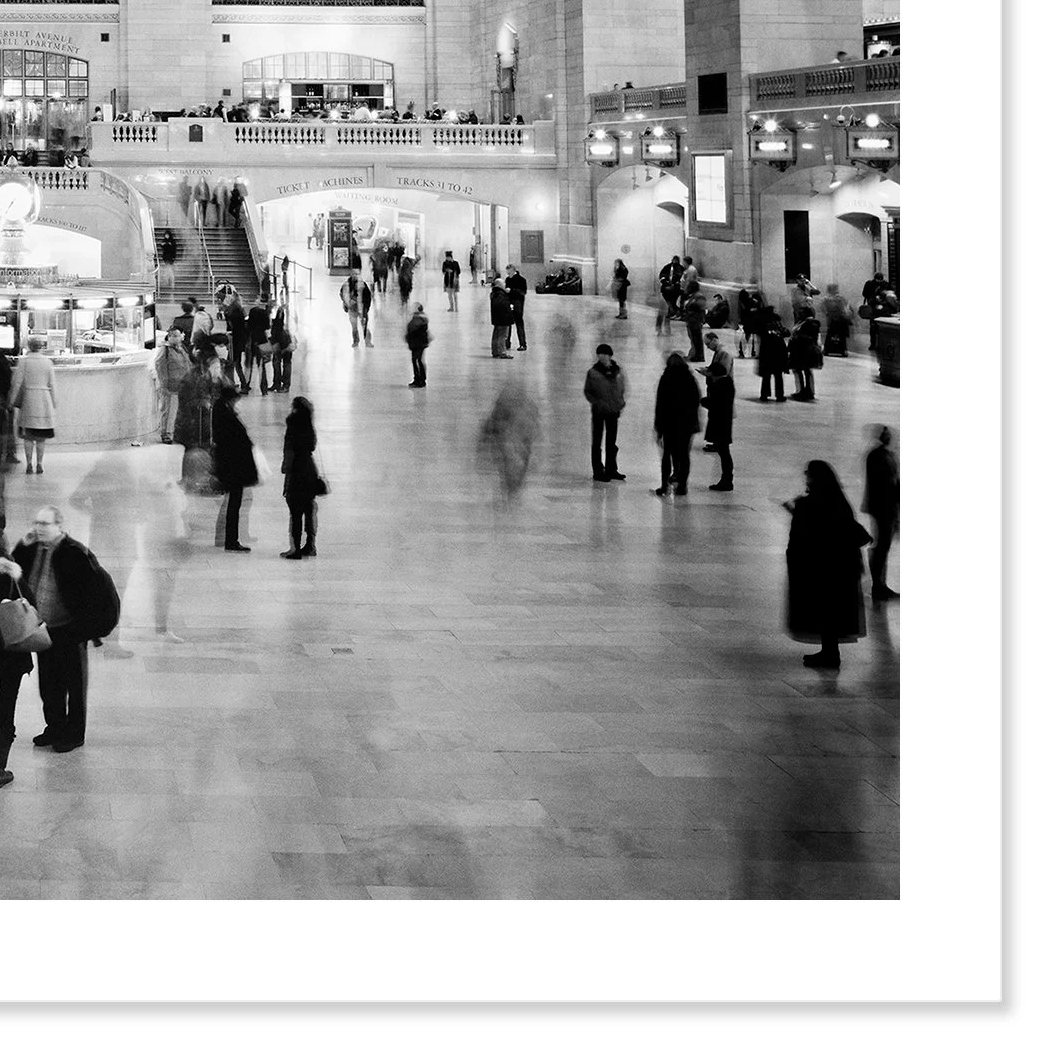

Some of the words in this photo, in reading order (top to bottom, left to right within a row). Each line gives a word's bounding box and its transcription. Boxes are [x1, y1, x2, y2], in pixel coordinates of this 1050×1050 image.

[24, 39, 80, 54] APARTMENT
[35, 32, 73, 45] AVENUE
[276, 181, 311, 195] TICKET
[316, 176, 364, 188] ACHINES
[396, 177, 436, 189] TRACKS
[437, 180, 446, 190] 31
[447, 182, 462, 193] TO
[462, 186, 473, 196] 42
